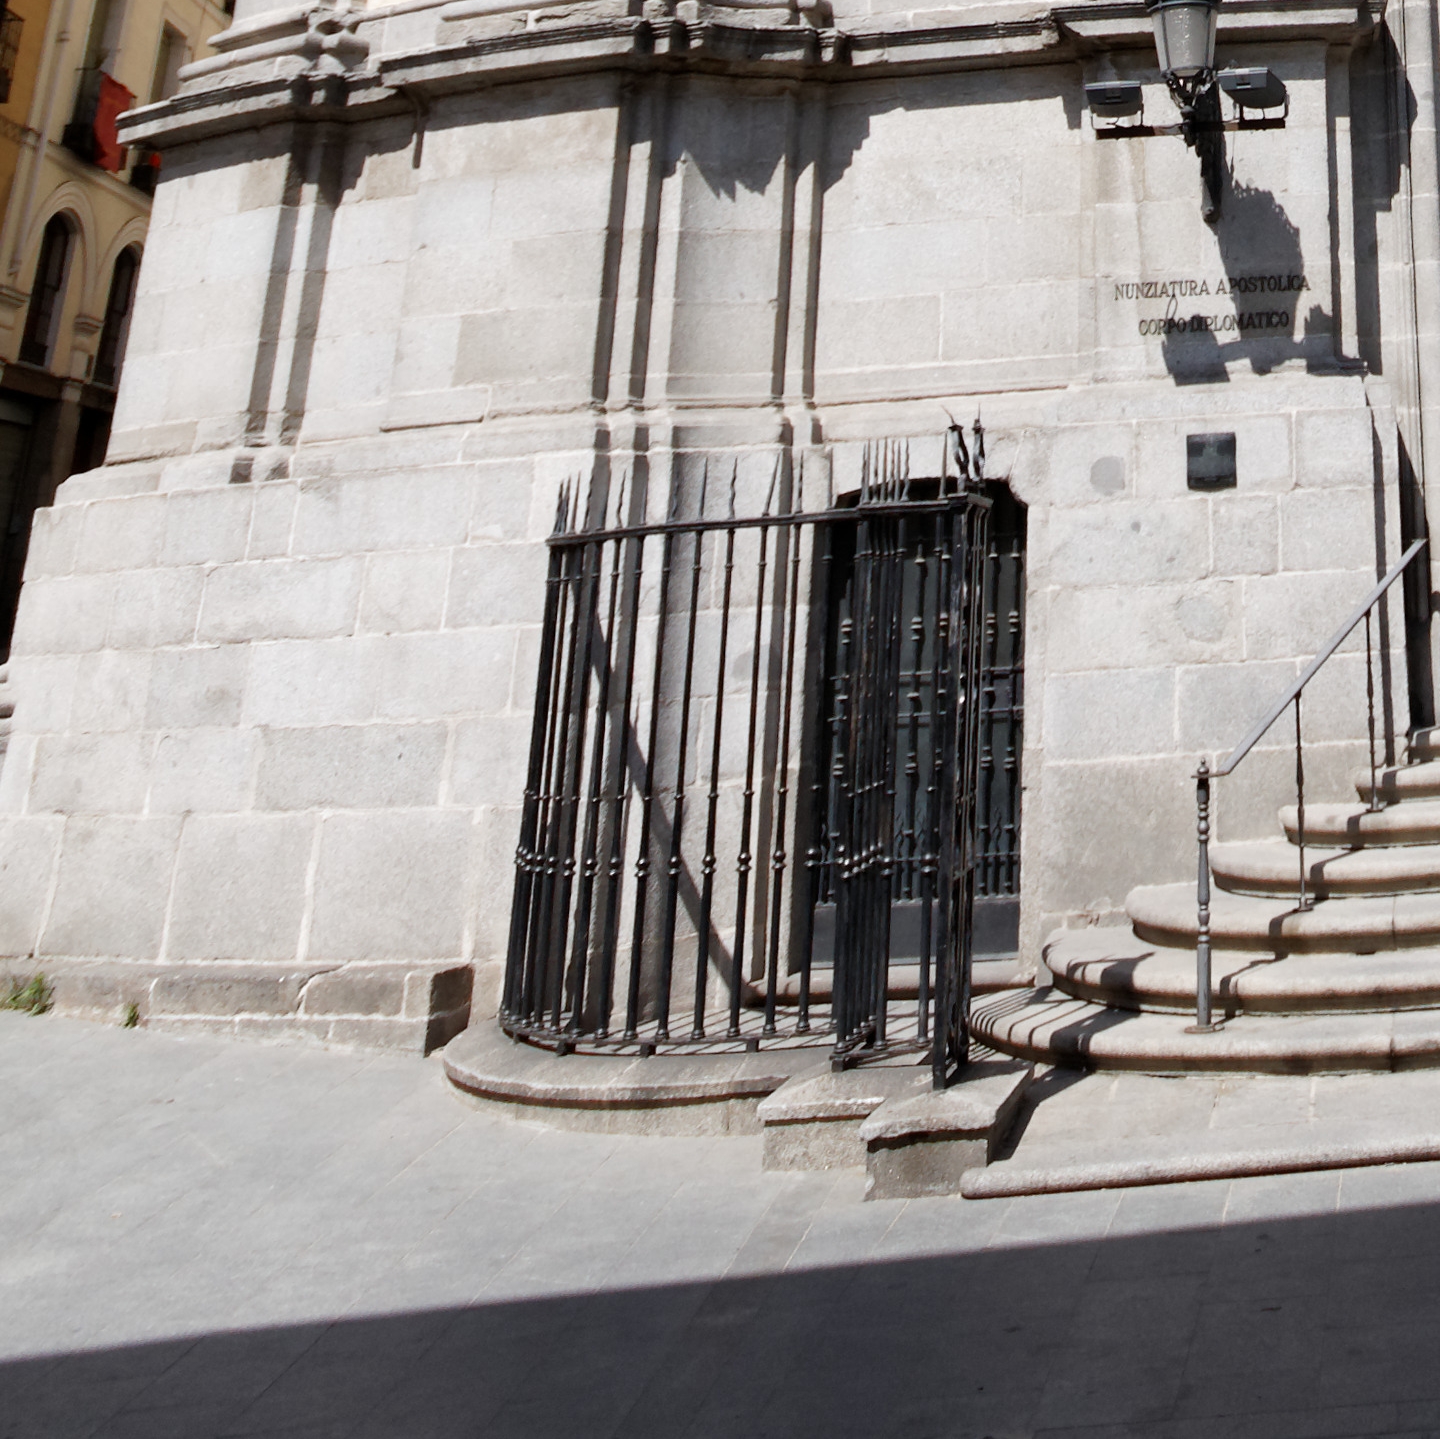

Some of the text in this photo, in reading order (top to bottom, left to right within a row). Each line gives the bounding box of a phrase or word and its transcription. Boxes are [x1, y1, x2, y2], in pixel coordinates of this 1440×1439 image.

[1114, 274, 1311, 300] NUNZIATURA APOSTOLICA
[1139, 311, 1290, 335] CORPO DIPLOMATICO
